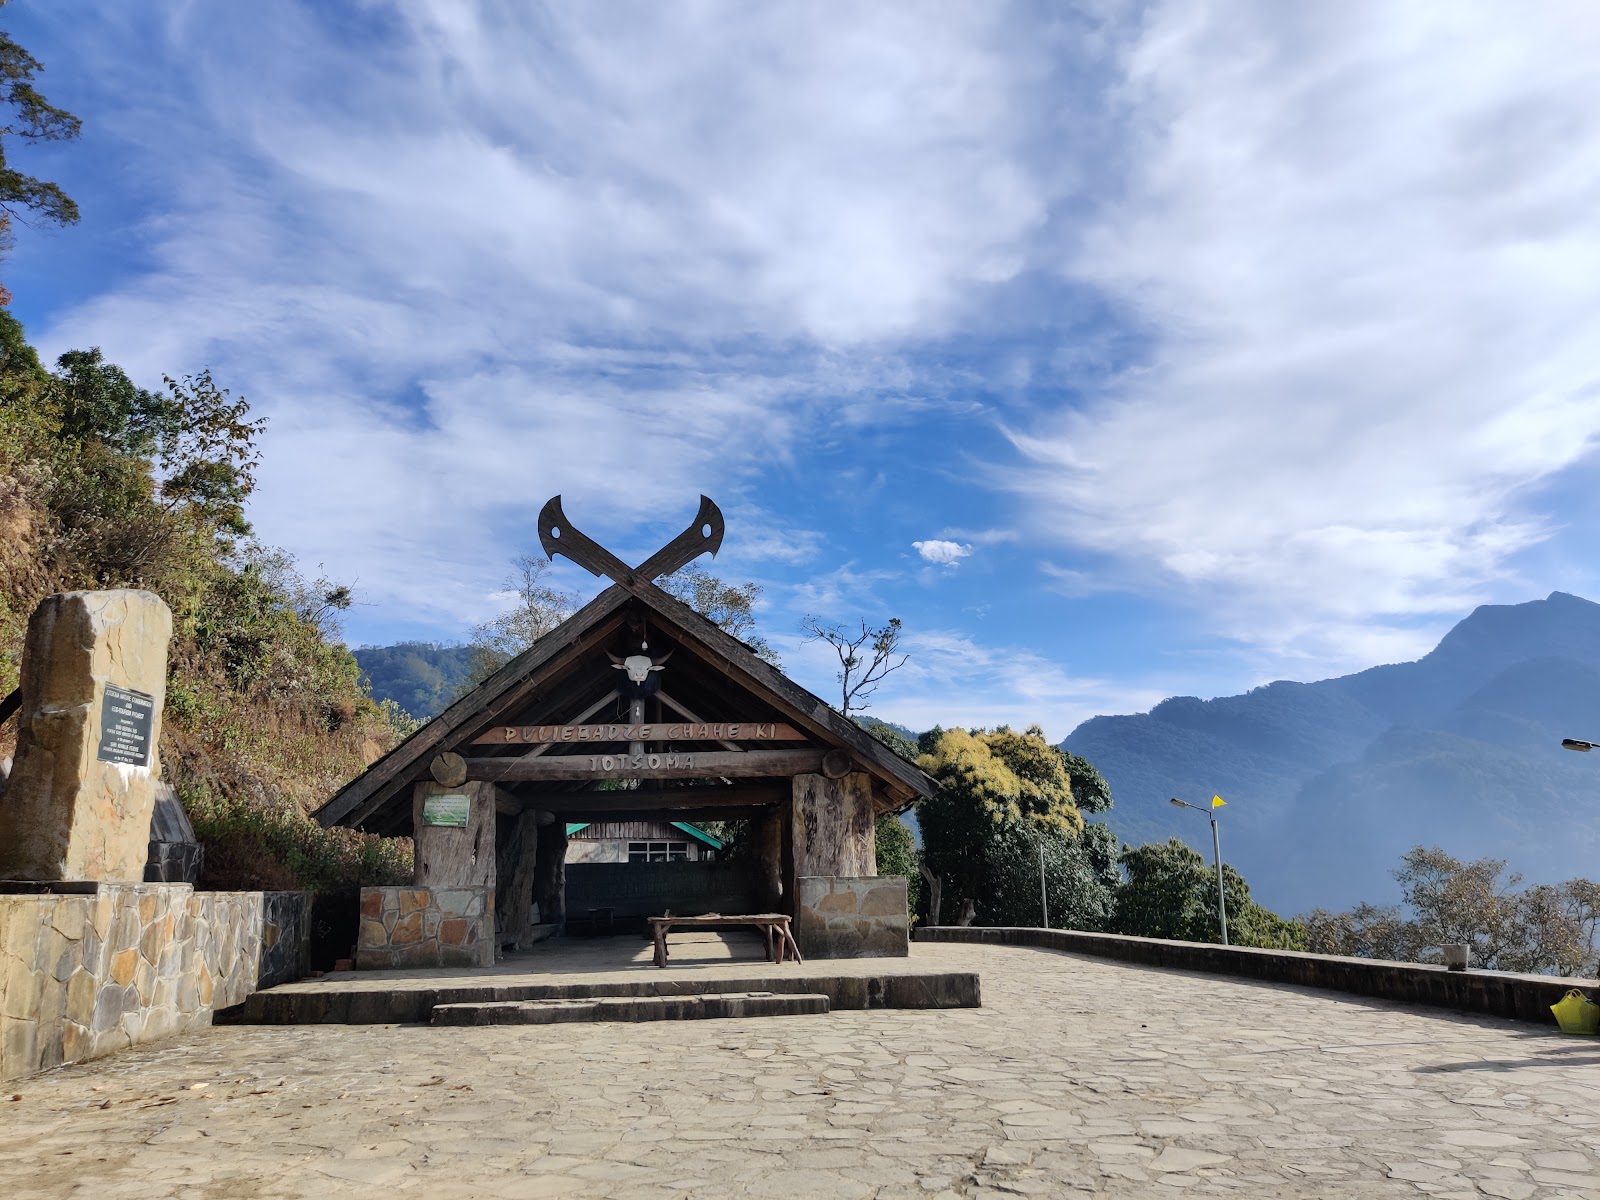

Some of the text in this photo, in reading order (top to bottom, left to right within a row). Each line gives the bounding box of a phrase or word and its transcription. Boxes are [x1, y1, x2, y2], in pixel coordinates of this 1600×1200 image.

[667, 724, 740, 739] CHAHE
[755, 723, 776, 739] KI
[589, 753, 696, 772] JOTSOMA
